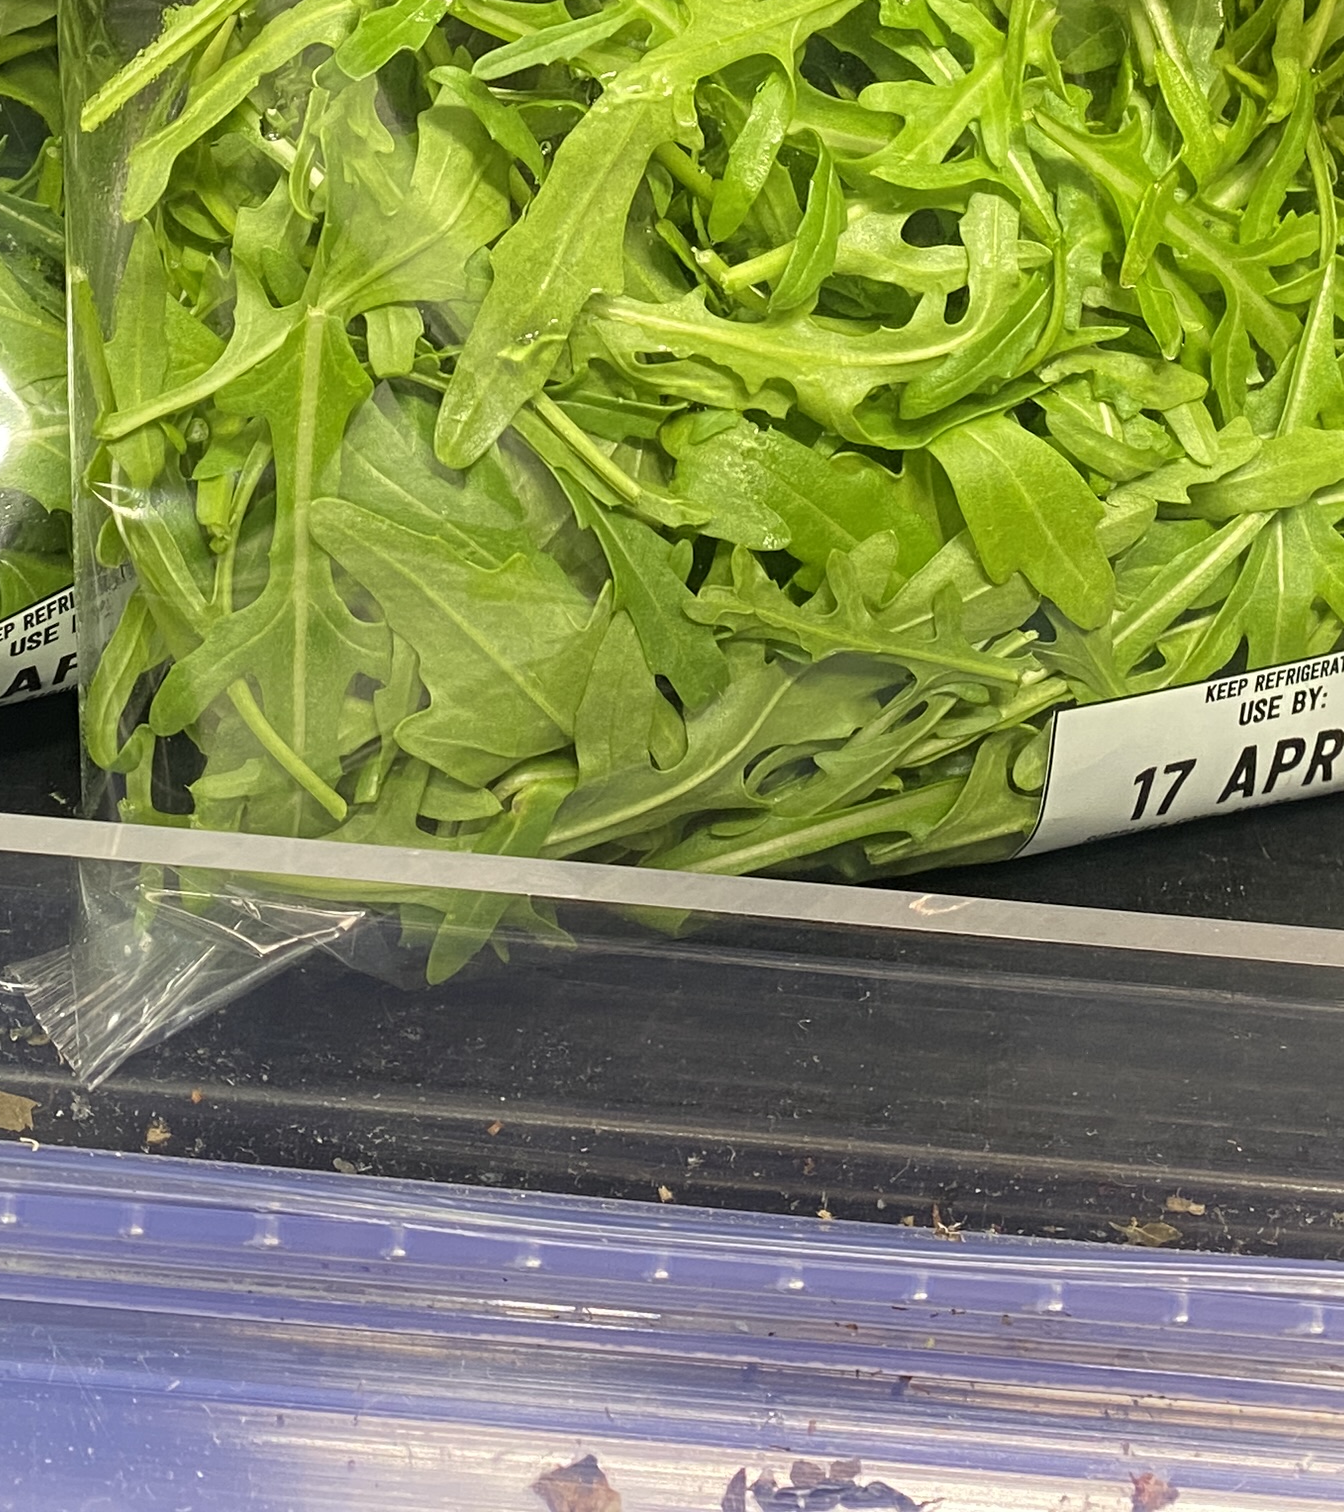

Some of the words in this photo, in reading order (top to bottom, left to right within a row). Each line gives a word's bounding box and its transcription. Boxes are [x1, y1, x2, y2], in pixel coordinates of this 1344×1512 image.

[9, 621, 61, 657] USE
[1205, 678, 1248, 703] KEEP
[1238, 695, 1283, 726] USE
[1291, 686, 1328, 715] BY:
[1130, 758, 1197, 821] 17
